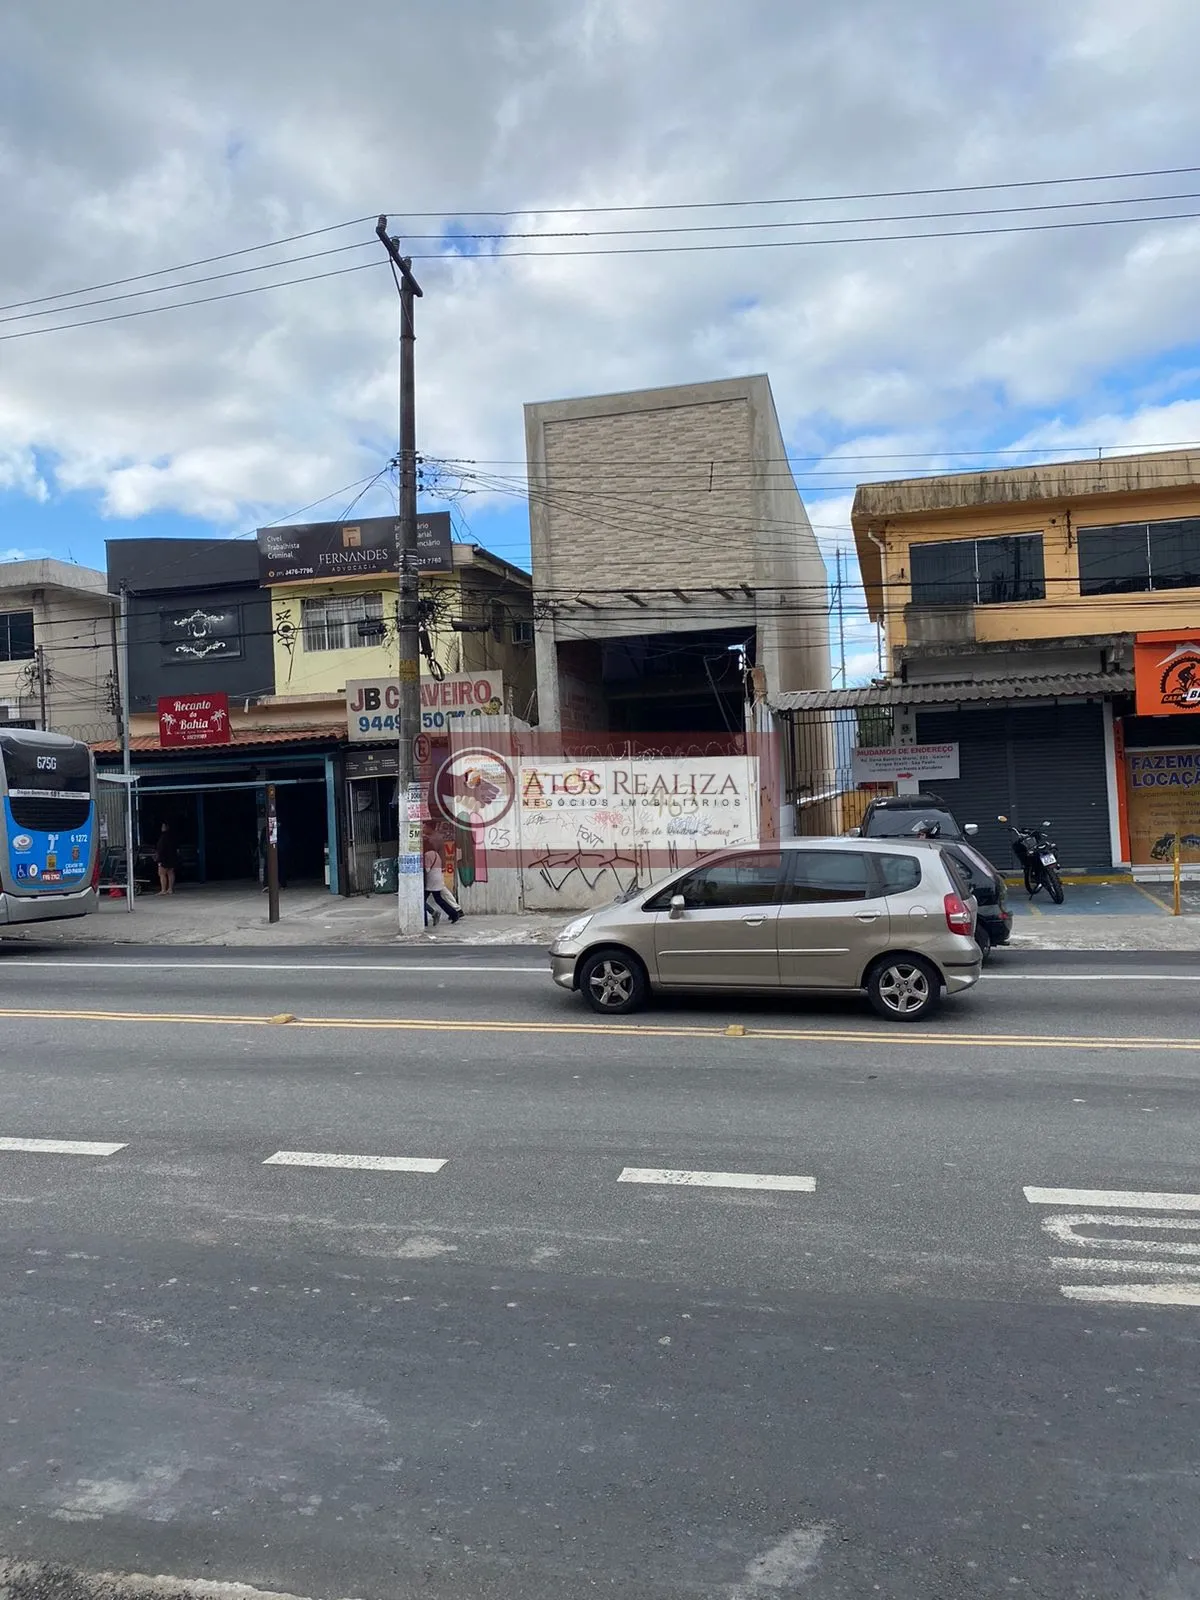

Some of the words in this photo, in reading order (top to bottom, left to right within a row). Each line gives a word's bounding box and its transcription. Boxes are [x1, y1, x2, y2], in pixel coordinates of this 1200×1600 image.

[267, 551, 294, 560] Criminal
[319, 548, 389, 565] FERNANDES
[173, 700, 211, 712] Recanto
[350, 687, 382, 713] JB
[179, 718, 209, 730] Bahia
[36, 756, 57, 770] 675G
